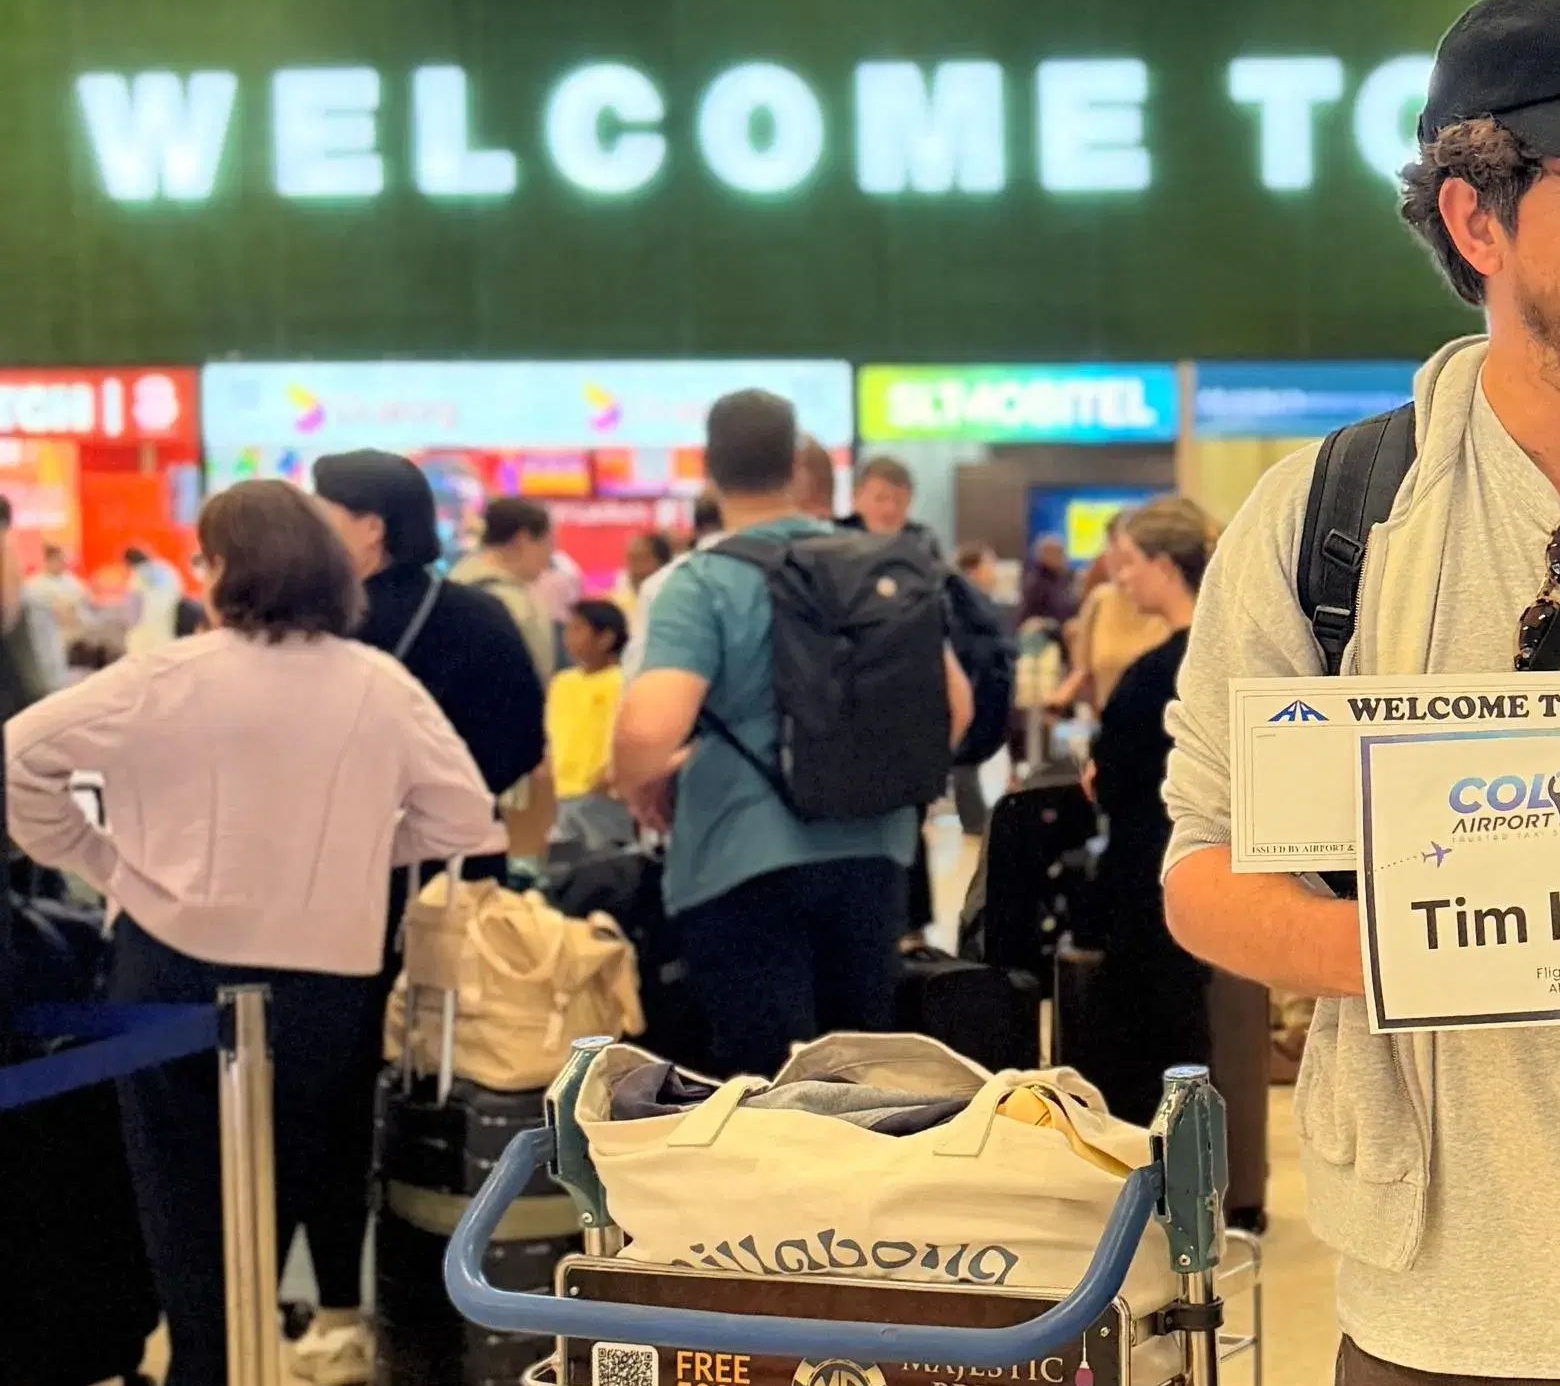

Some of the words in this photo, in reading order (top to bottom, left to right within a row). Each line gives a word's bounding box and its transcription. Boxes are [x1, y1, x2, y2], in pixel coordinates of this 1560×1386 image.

[76, 57, 1152, 203] WELCOME
[1347, 694, 1530, 722] WELCOME
[1452, 812, 1555, 834] AIRPORT
[1303, 845, 1344, 854] AIRPORT
[1411, 896, 1528, 950] Tim
[676, 1350, 751, 1385] FREE
